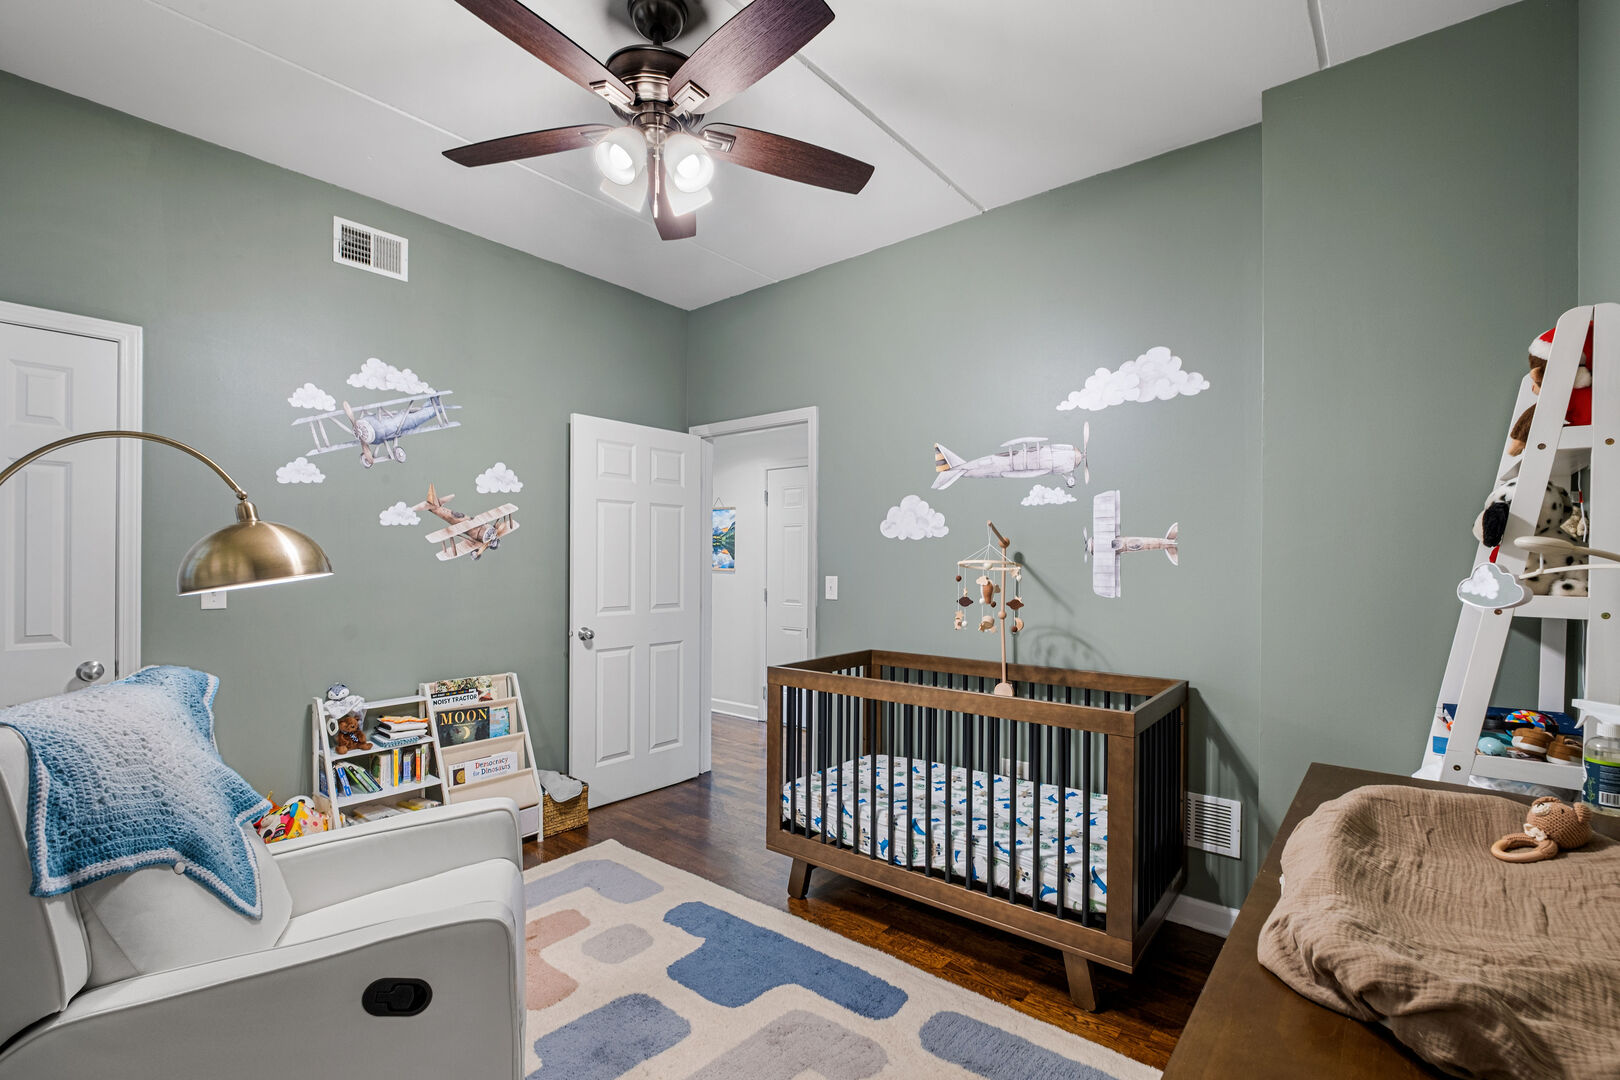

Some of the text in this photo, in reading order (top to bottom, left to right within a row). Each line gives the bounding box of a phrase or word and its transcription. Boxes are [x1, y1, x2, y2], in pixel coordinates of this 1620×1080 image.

[433, 698, 451, 706] NOISY
[452, 694, 477, 703] TRACTOR
[441, 708, 488, 726] MOON
[475, 757, 508, 769] Democracy
[481, 763, 511, 775] Dinosaurs
